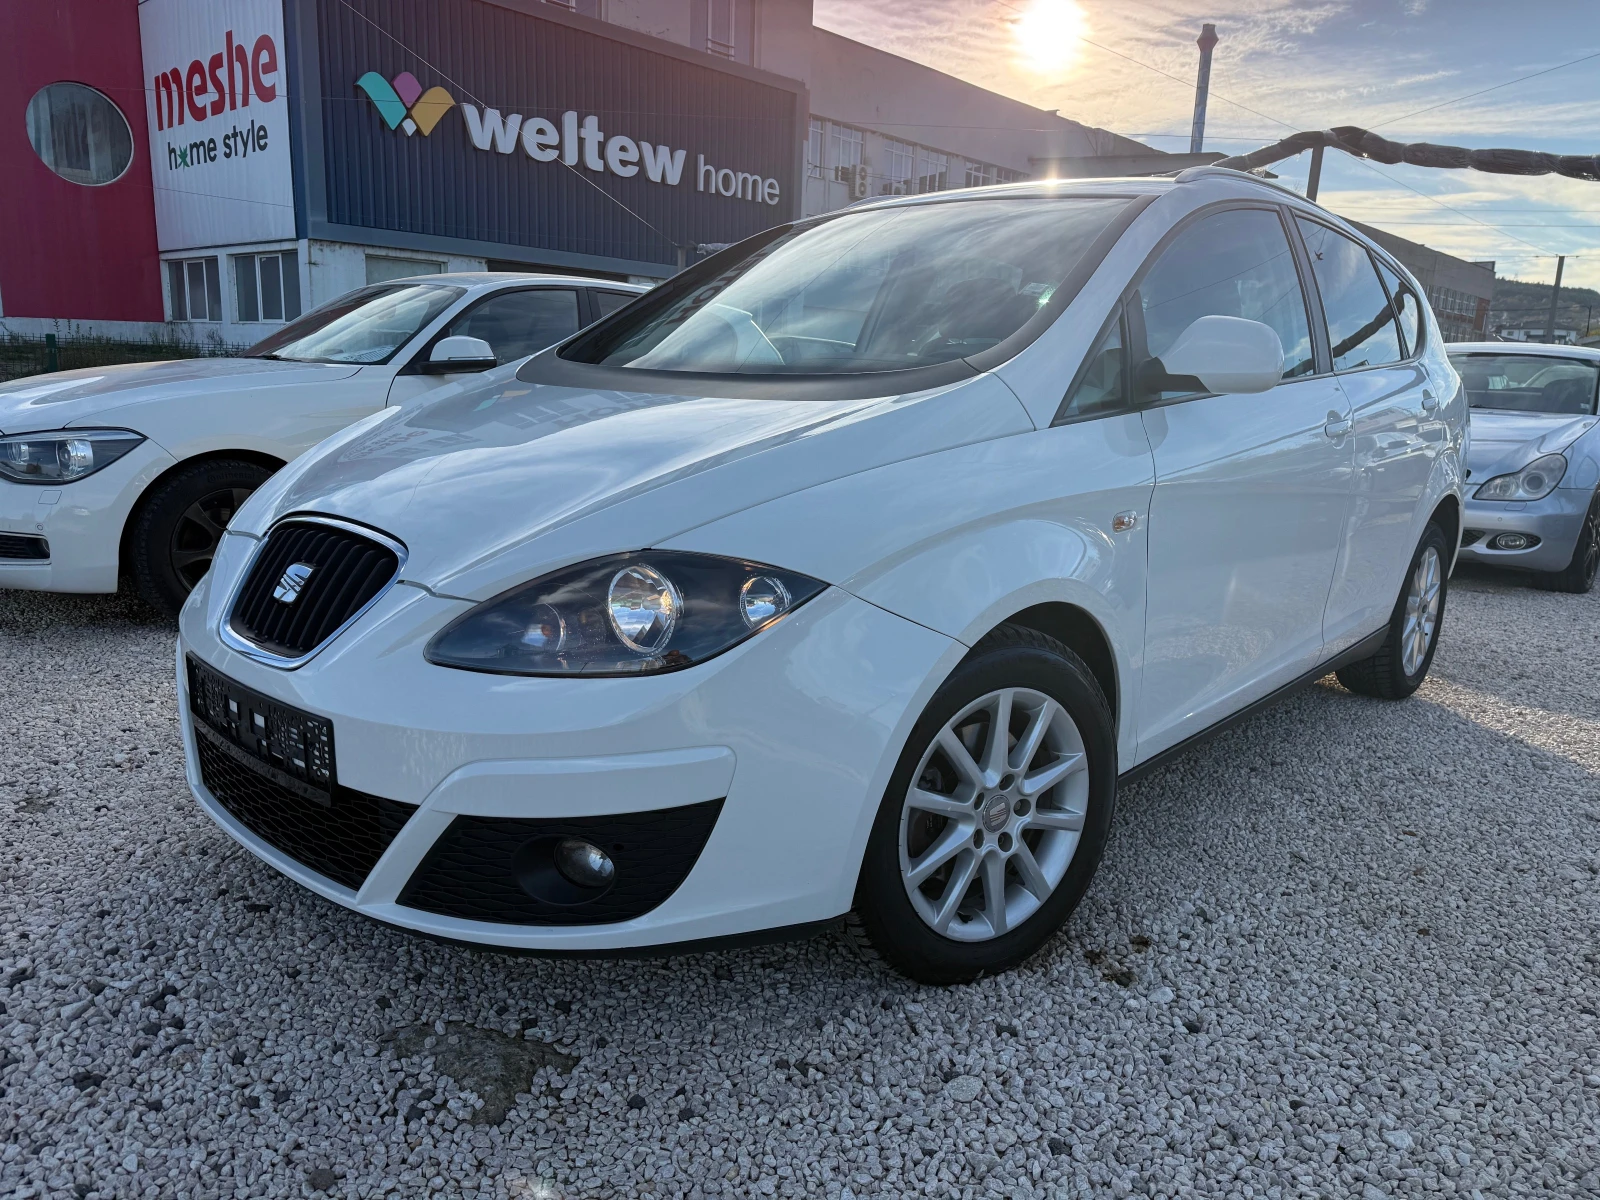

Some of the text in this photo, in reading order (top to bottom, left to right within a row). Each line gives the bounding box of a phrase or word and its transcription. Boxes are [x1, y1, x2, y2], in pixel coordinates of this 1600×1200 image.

[154, 29, 278, 131] meshe
[222, 119, 269, 159] style
[461, 102, 780, 205] weltew home
